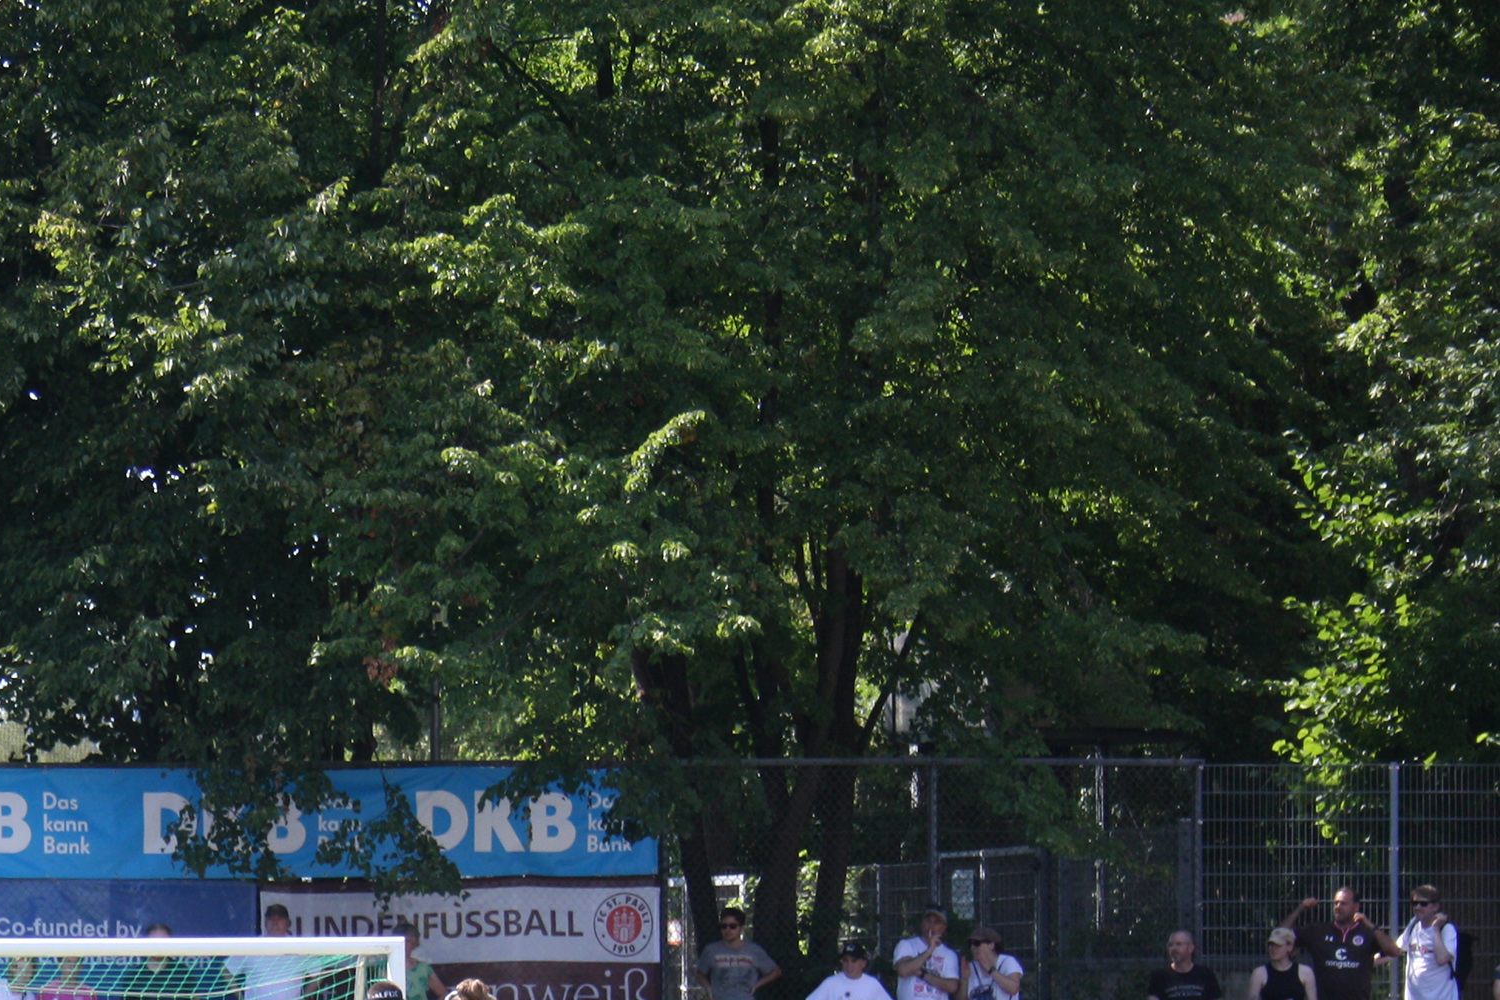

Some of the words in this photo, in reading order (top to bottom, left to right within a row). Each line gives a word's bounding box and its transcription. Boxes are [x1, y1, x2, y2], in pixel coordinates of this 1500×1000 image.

[43, 792, 78, 811] Das
[587, 791, 614, 809] Da
[43, 814, 88, 832] kann
[415, 790, 576, 853] DKB
[43, 837, 90, 854] Bank
[587, 834, 632, 853] Bank
[625, 896, 650, 923] PAULI
[116, 921, 142, 937] by
[613, 944, 635, 954] 1910
